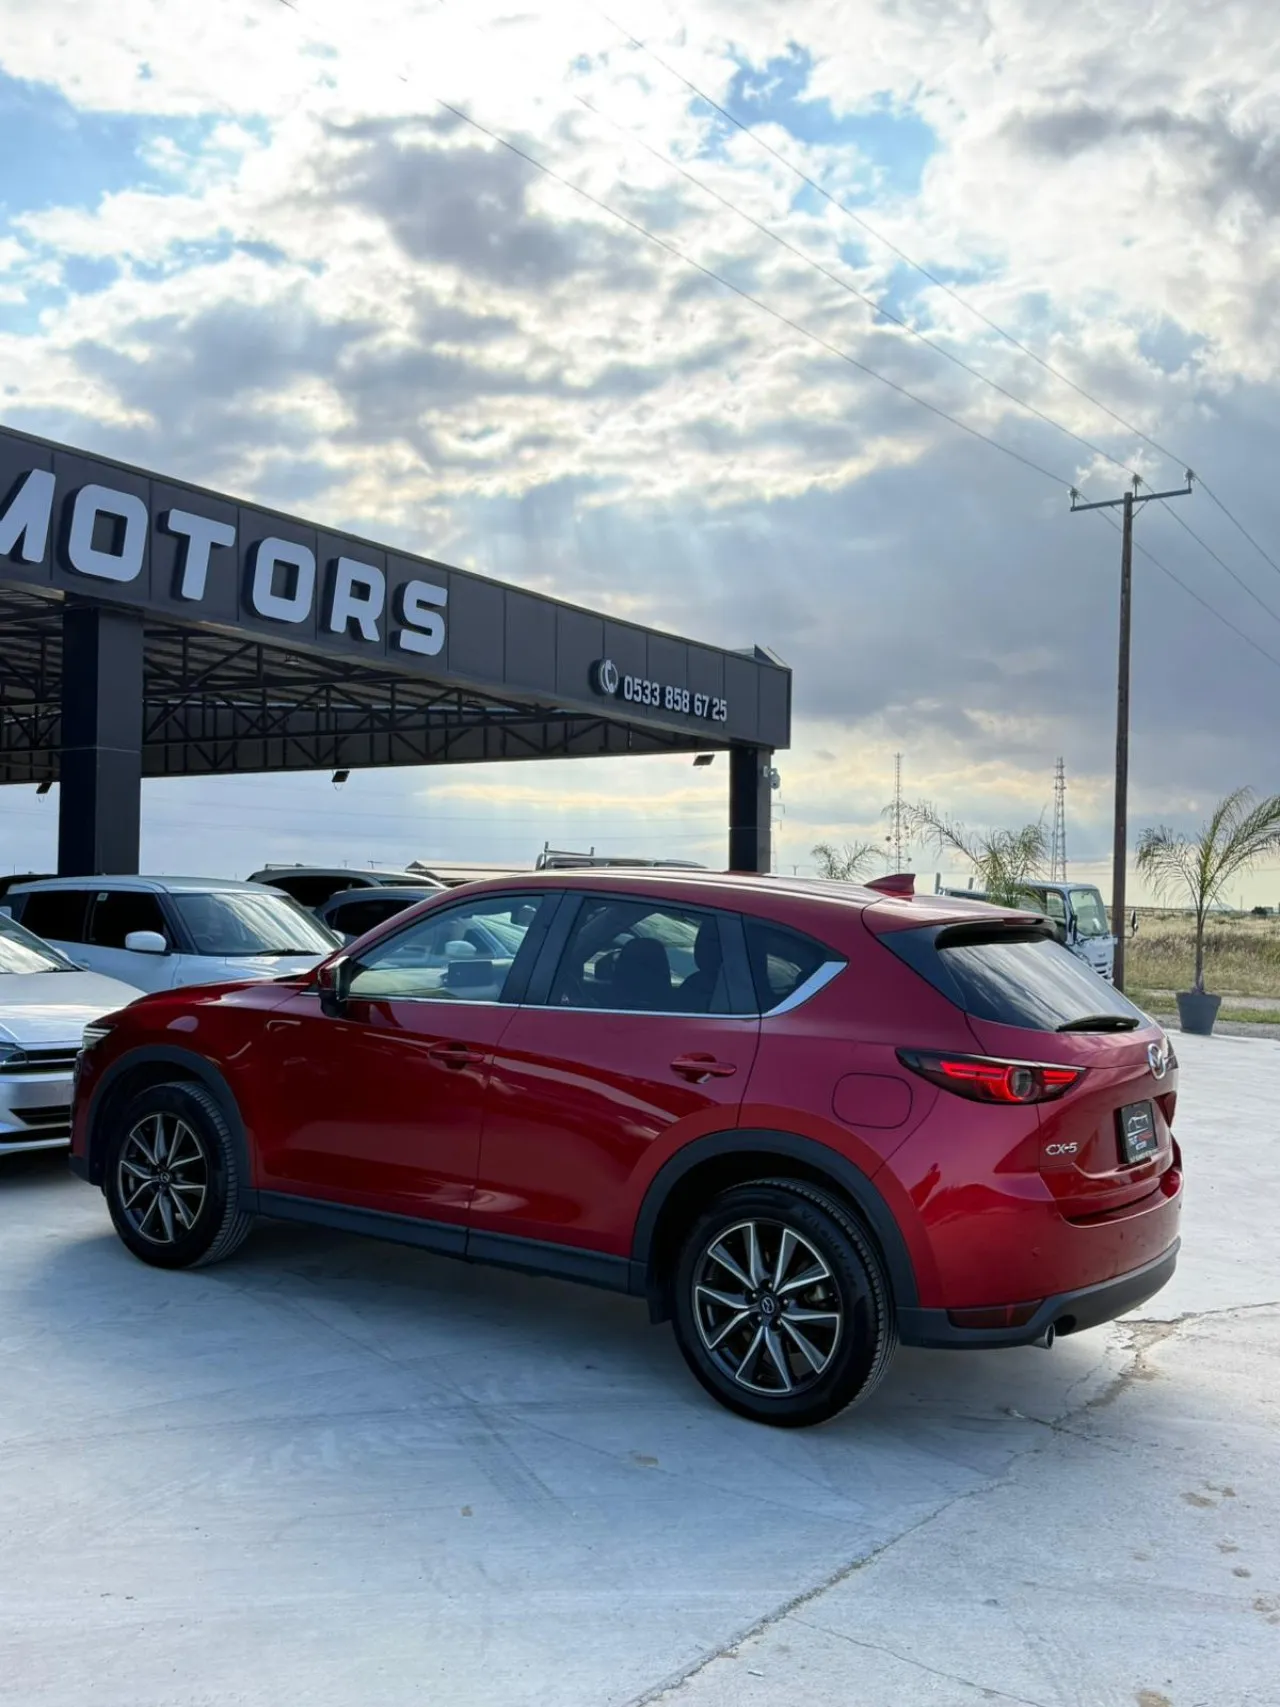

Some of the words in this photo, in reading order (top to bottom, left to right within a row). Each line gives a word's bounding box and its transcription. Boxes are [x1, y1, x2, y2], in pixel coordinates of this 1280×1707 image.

[624, 675, 660, 706] 0533
[665, 685, 690, 713] 858
[694, 693, 710, 718] 67
[712, 698, 727, 722] 25
[1045, 1141, 1078, 1155] CX-5
